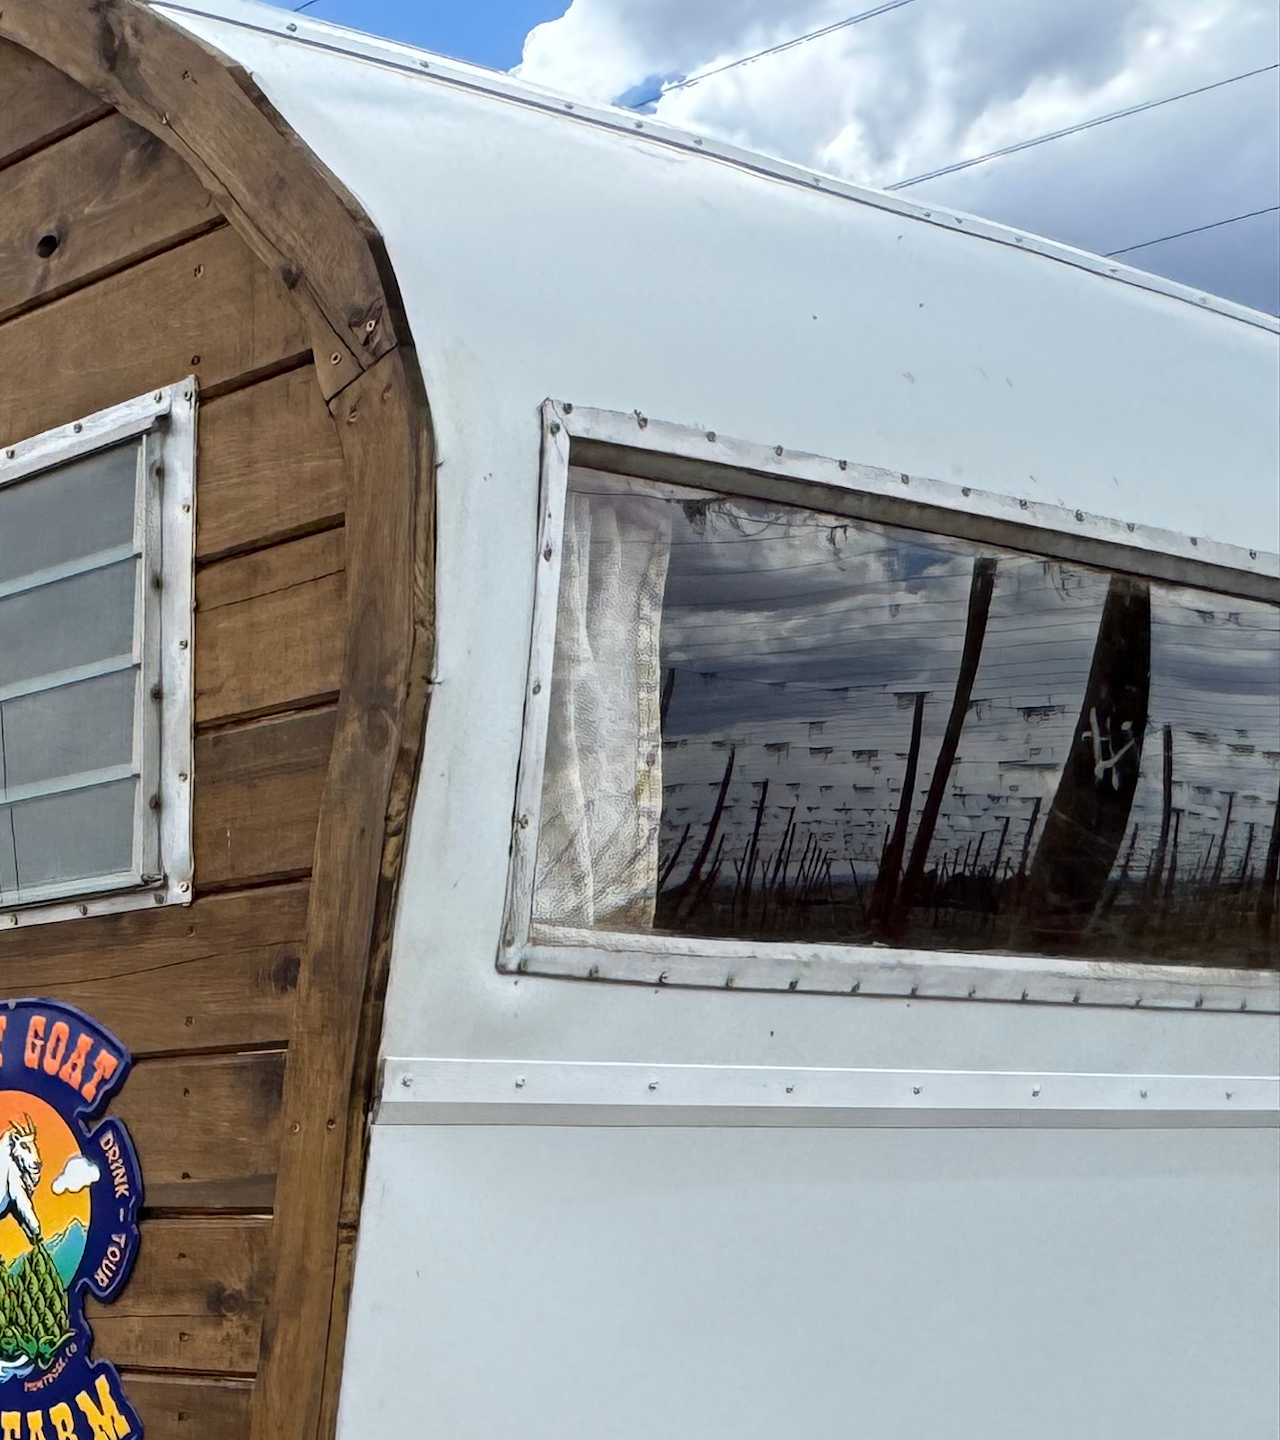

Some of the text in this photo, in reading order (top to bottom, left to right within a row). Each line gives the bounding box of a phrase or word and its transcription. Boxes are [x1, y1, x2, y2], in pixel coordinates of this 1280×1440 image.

[24, 1015, 119, 1103] GOAT
[98, 1129, 130, 1198] DRINK
[94, 1233, 127, 1288] TOUR
